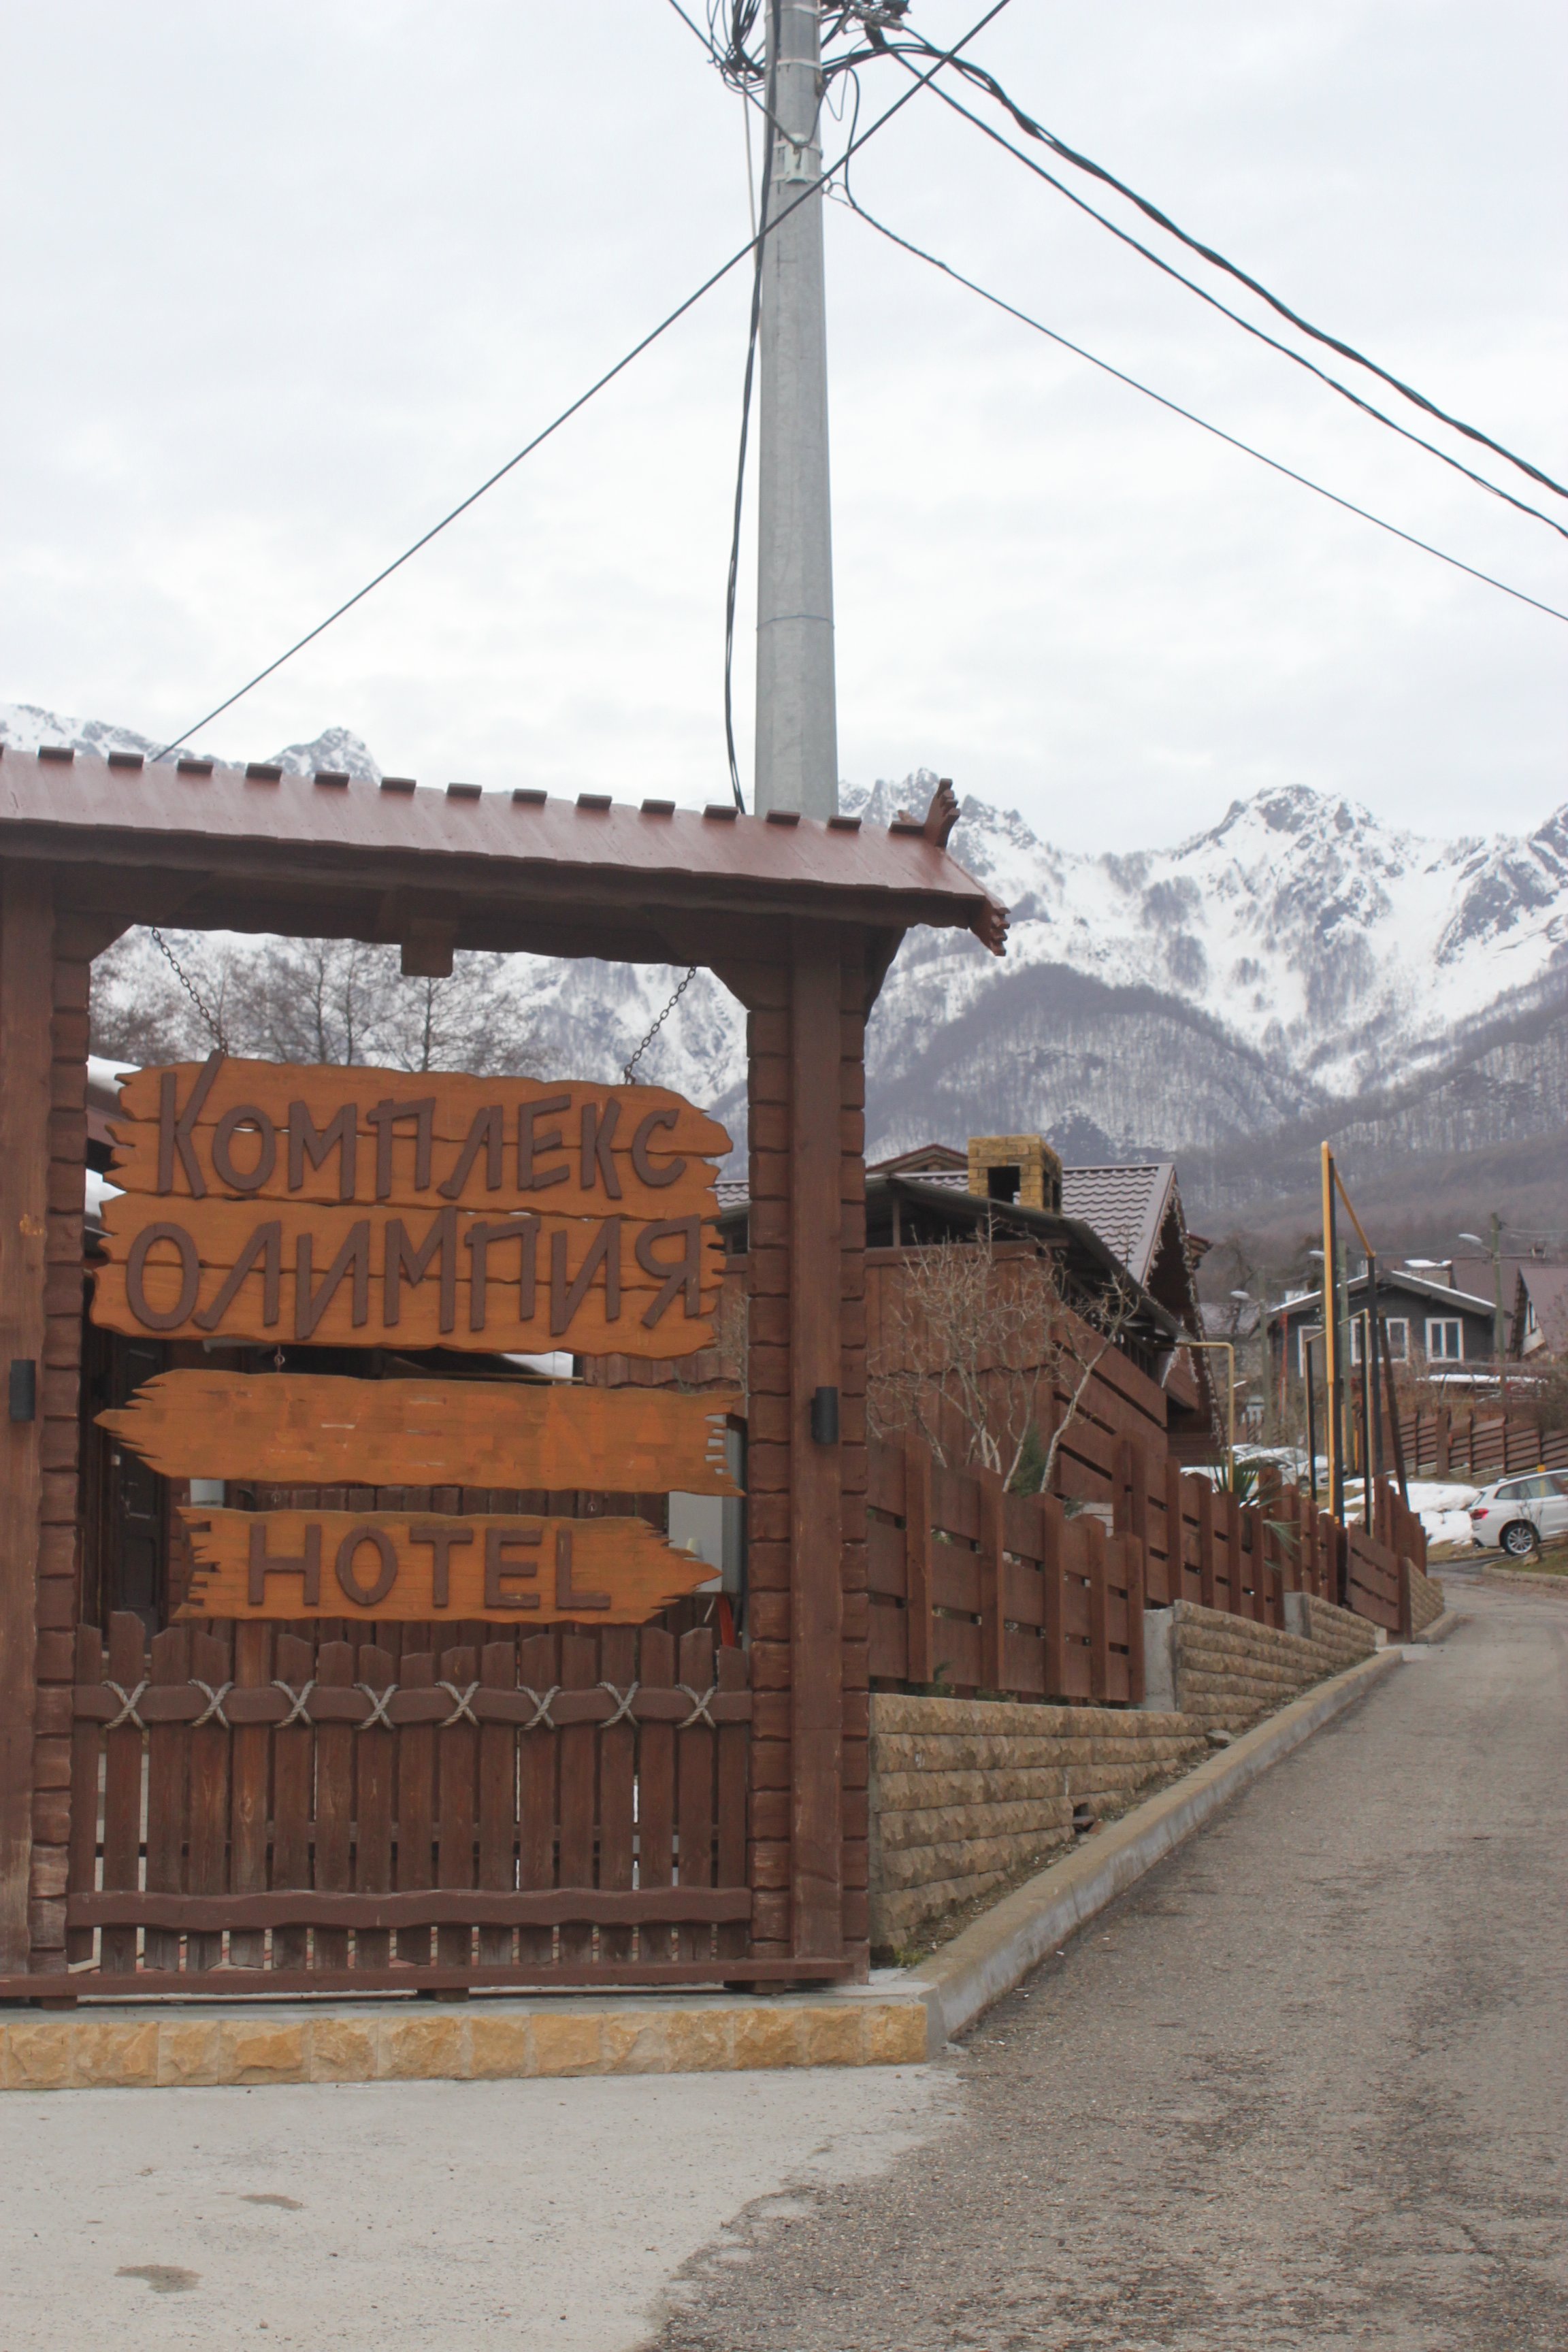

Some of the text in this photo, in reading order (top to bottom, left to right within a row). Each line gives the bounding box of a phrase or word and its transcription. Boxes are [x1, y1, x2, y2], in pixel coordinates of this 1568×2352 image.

[157, 1050, 686, 1200] КОМПЛЕКС
[125, 1208, 701, 1339] ОЛИМПИЯ
[248, 1524, 611, 1610] HOTEL
